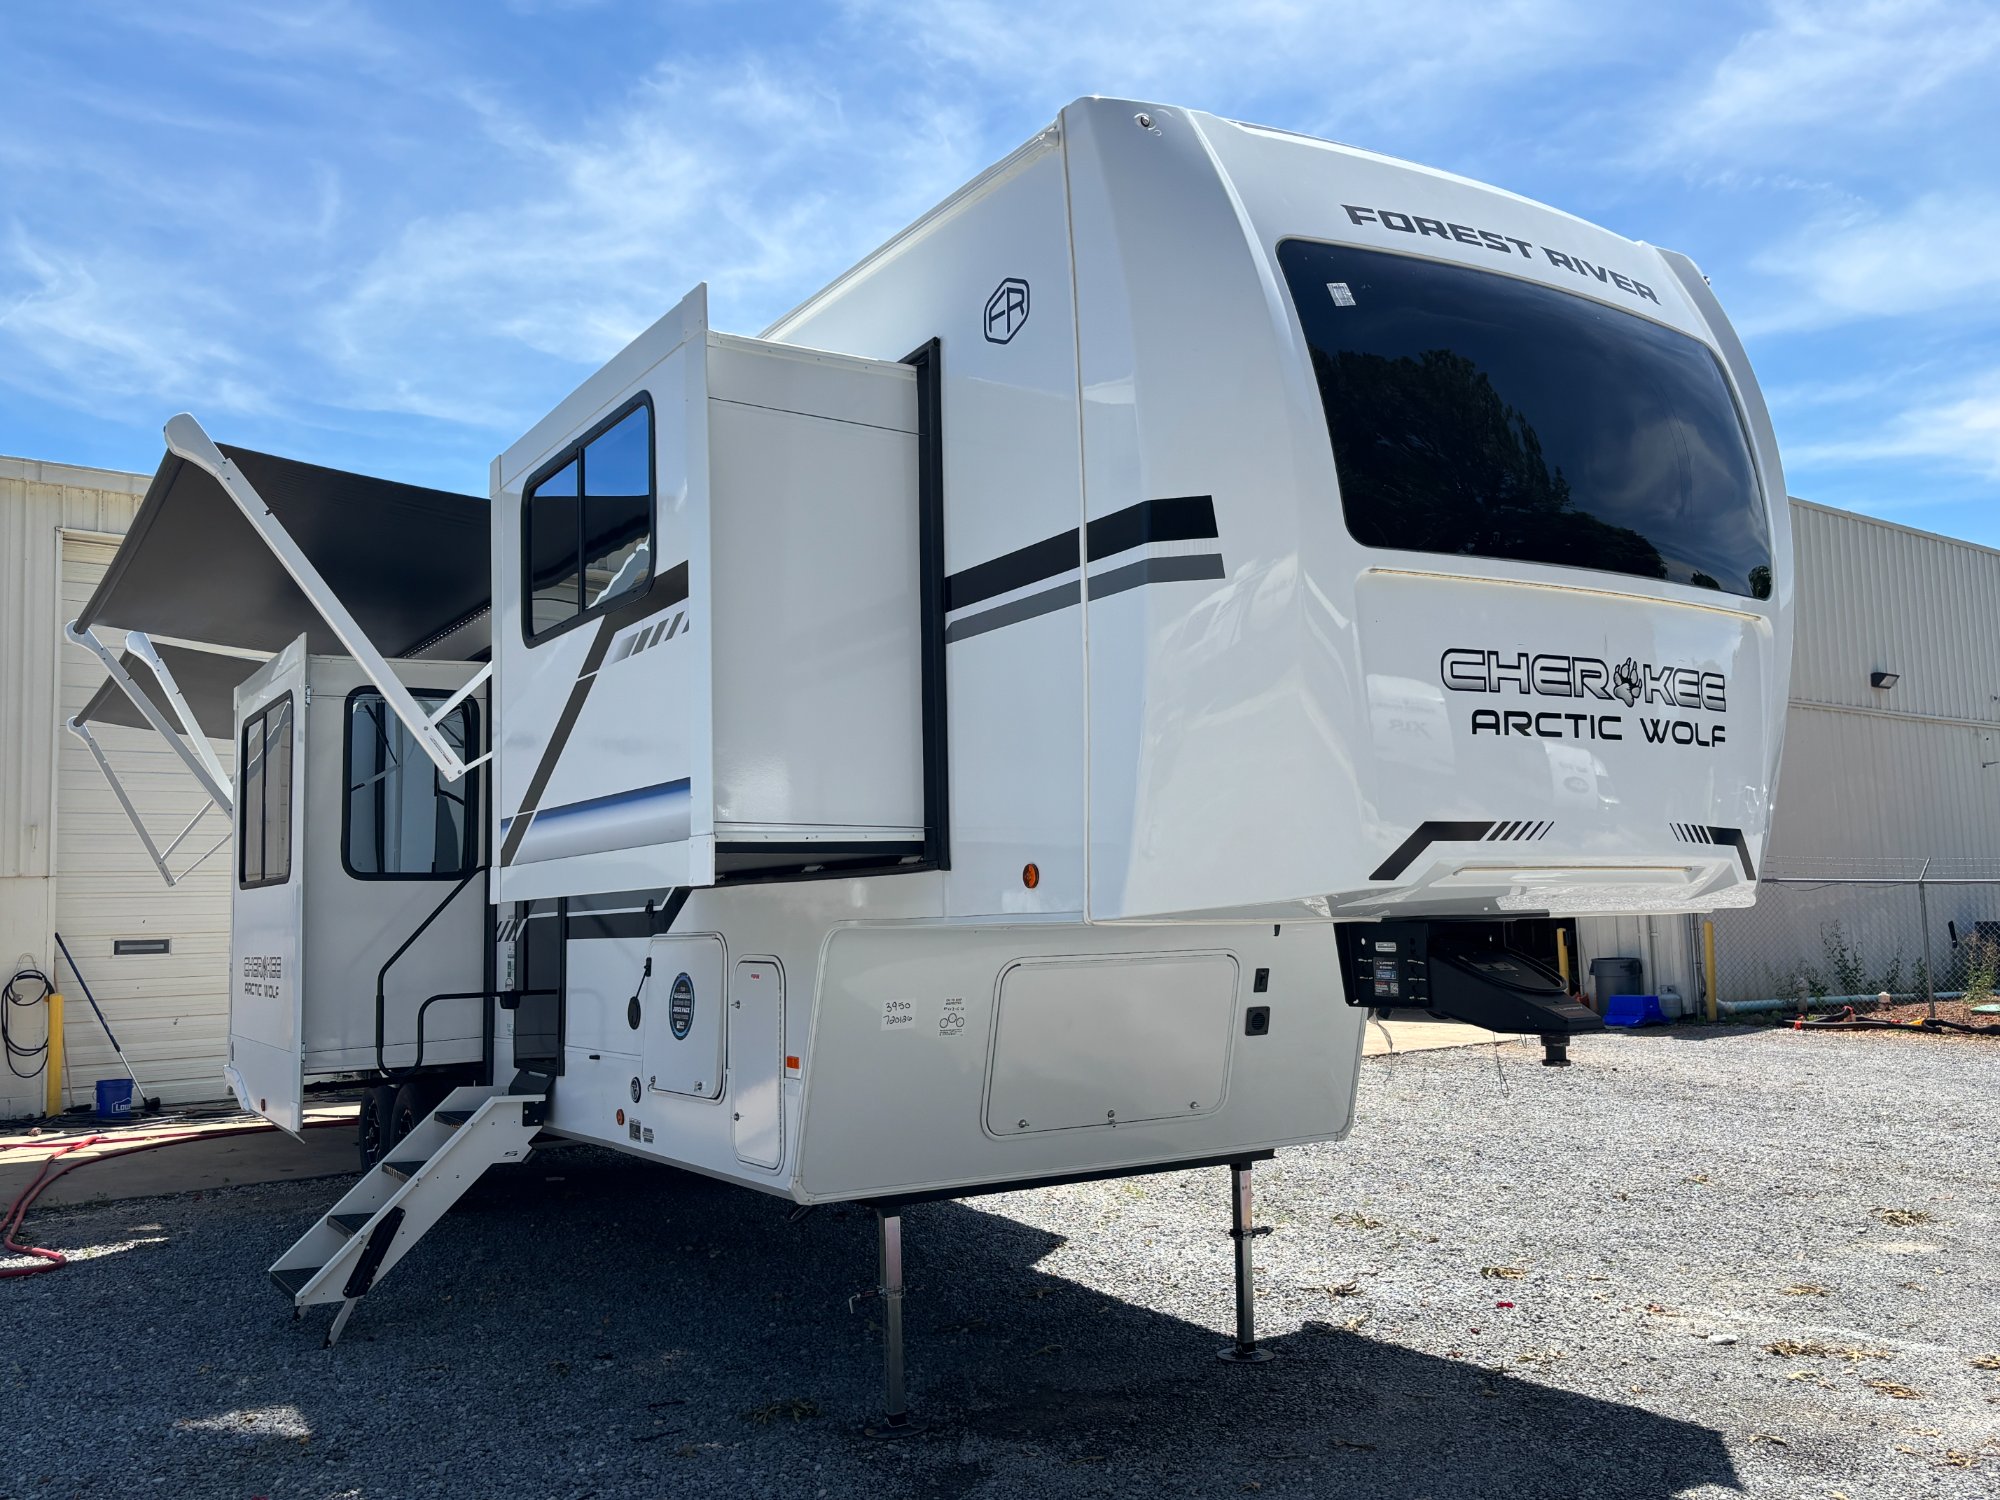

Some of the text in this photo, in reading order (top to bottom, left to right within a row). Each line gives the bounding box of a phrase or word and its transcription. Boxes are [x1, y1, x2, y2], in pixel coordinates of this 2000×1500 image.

[1341, 204, 1662, 306] FOREST RIVER
[1471, 709, 1726, 747] ARCTIC WOLF
